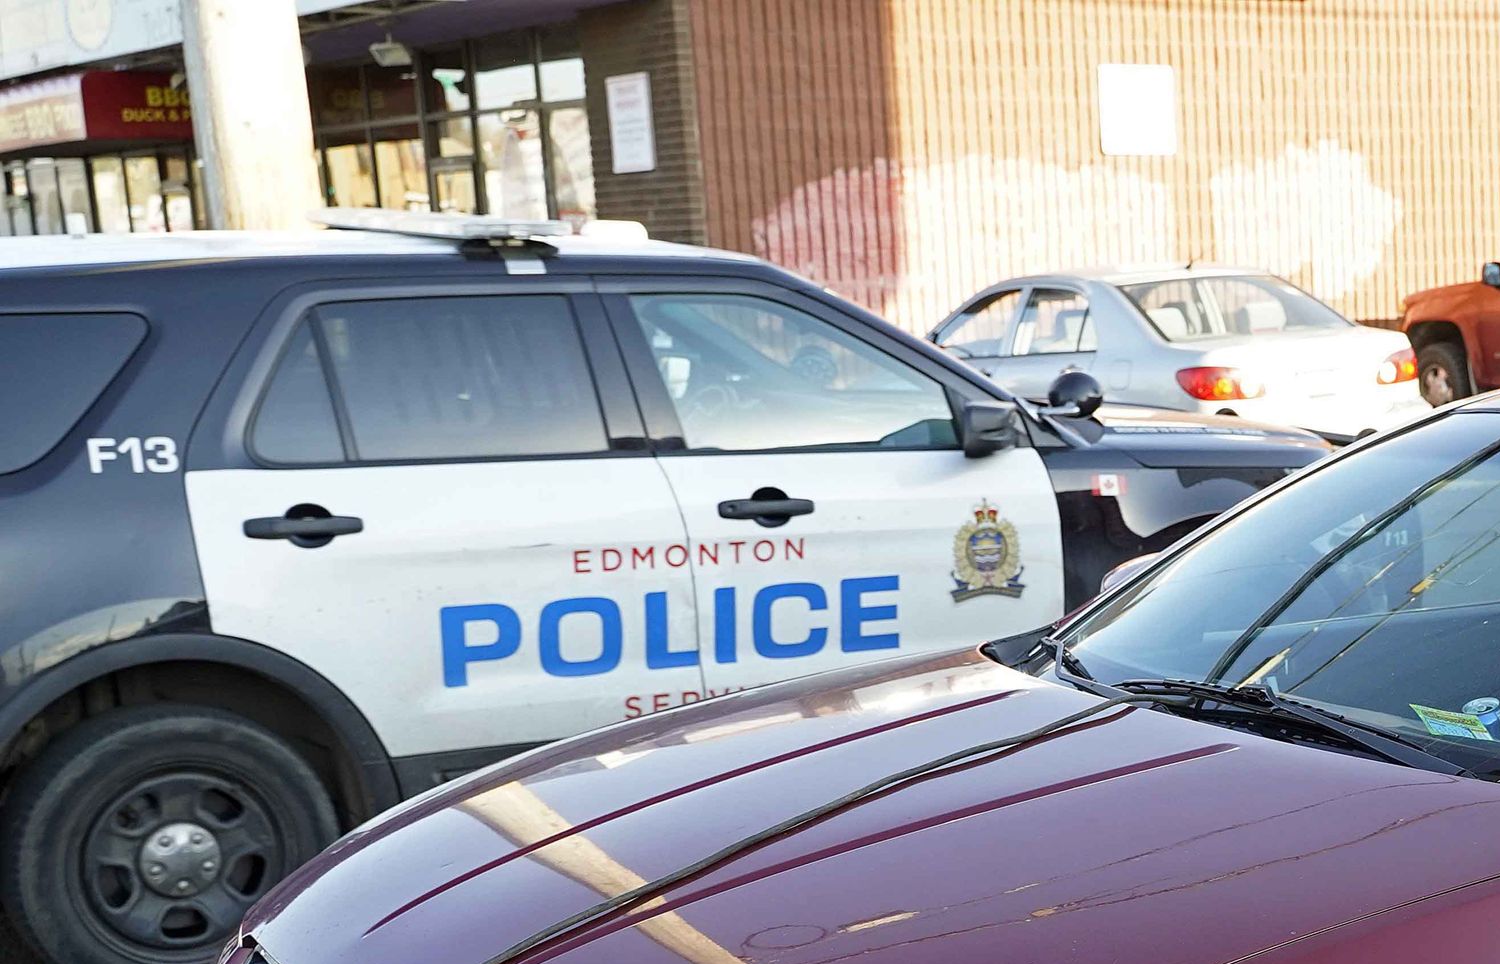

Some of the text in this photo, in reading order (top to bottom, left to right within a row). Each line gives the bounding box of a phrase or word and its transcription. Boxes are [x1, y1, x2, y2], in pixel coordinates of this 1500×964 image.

[121, 107, 165, 123] DUCK
[86, 436, 180, 474] F13
[573, 537, 806, 573] EDMONTON
[440, 574, 900, 688] POLICE
